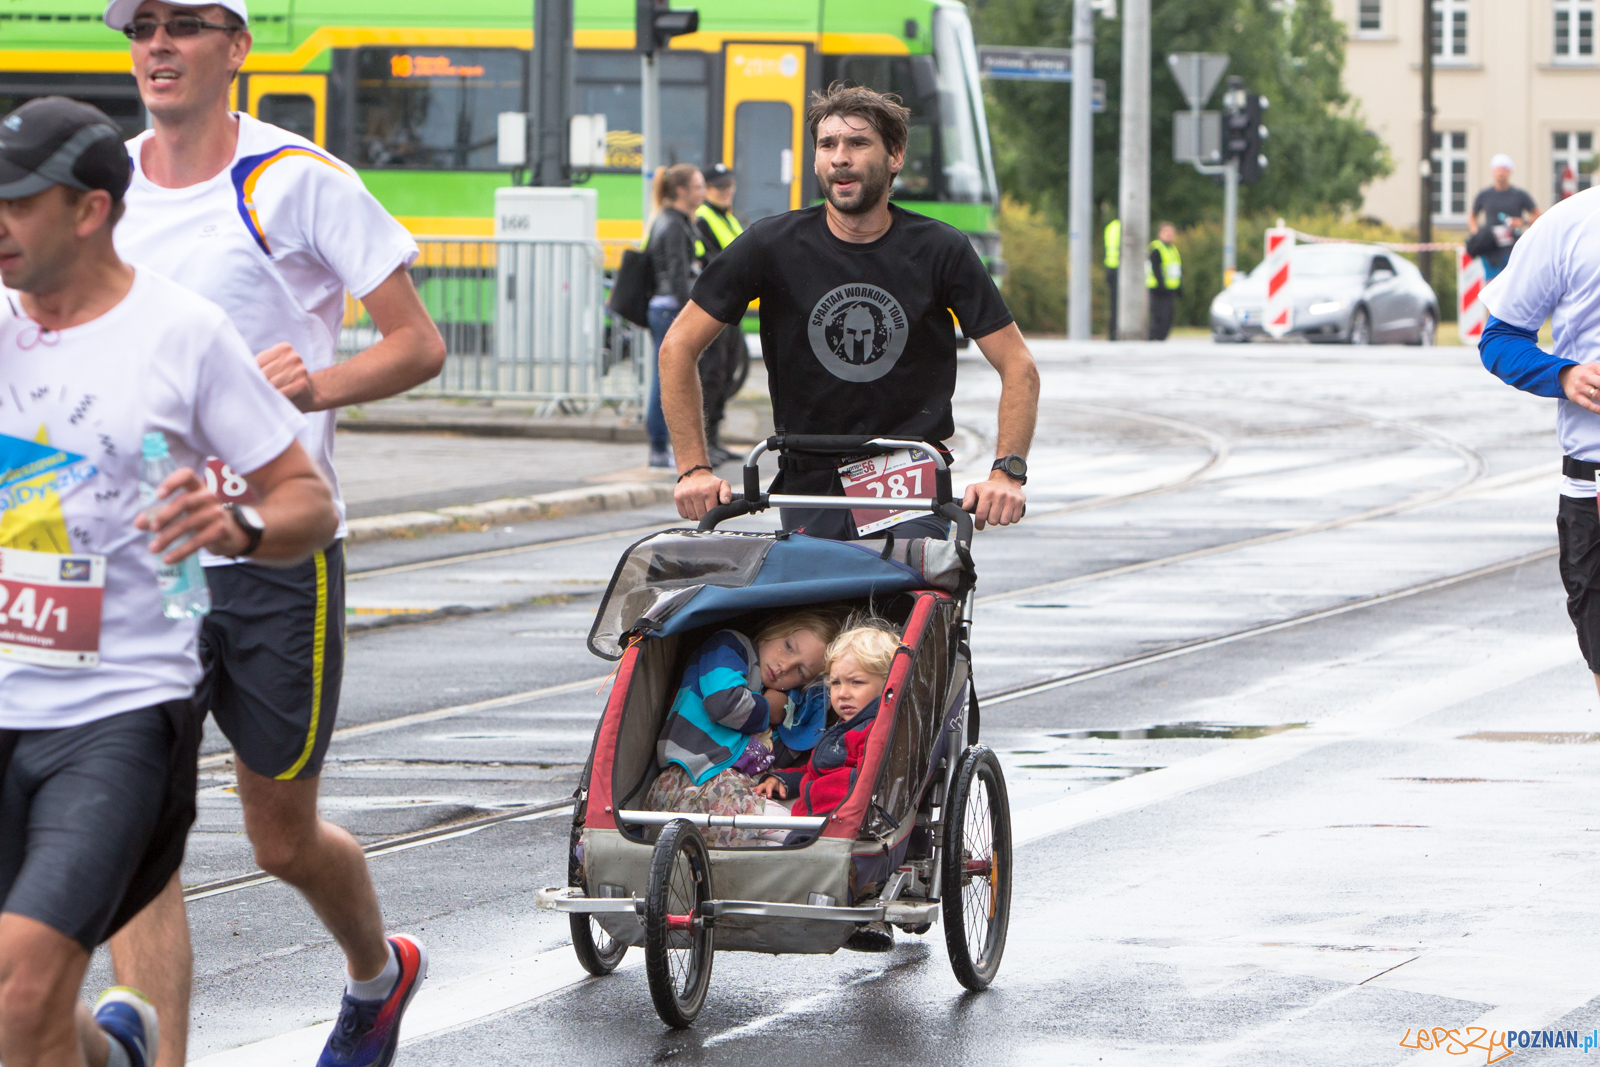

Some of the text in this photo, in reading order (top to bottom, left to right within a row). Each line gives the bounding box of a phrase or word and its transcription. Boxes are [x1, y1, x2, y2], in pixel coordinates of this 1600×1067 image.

[501, 214, 530, 231] 166
[812, 286, 905, 330] SPARTAN WORKOUT TOUR
[865, 467, 923, 499] 287
